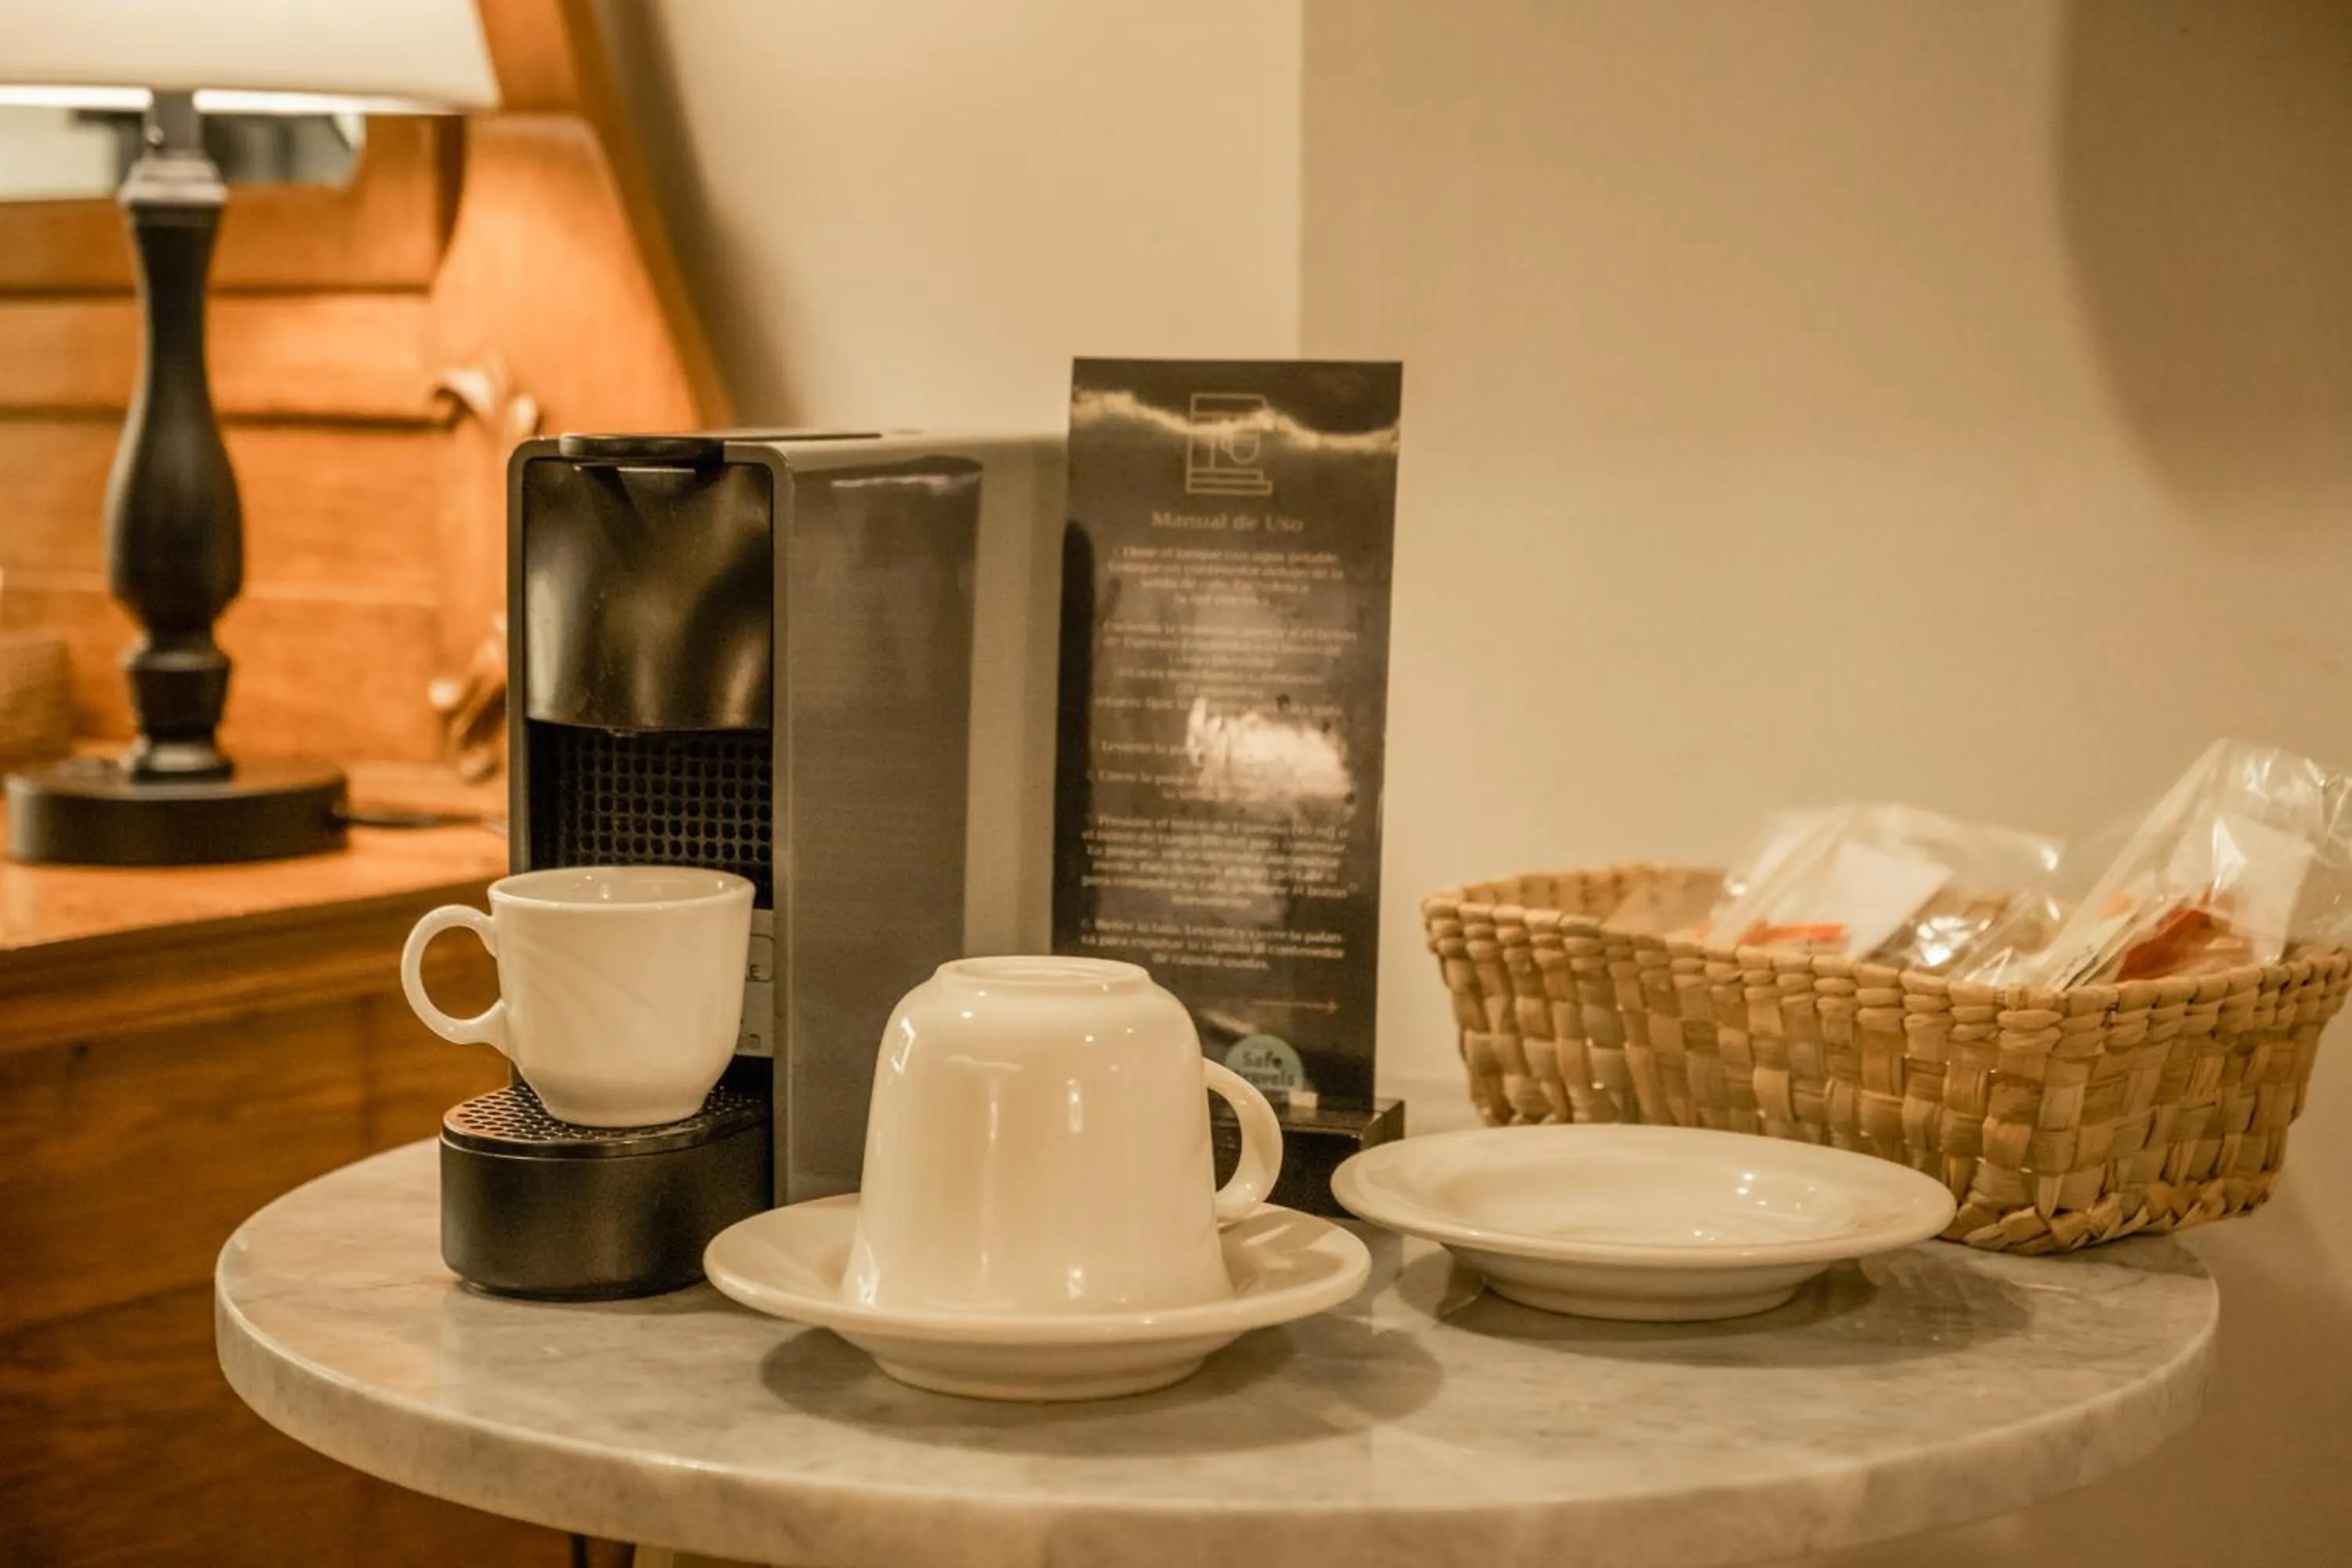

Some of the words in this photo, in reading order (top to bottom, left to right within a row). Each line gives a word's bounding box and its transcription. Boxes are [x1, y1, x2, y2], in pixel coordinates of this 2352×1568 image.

[1151, 510, 1228, 530] Manual
[1232, 514, 1258, 531] de
[1264, 513, 1305, 532] Uso
[1242, 1051, 1283, 1069] Safe
